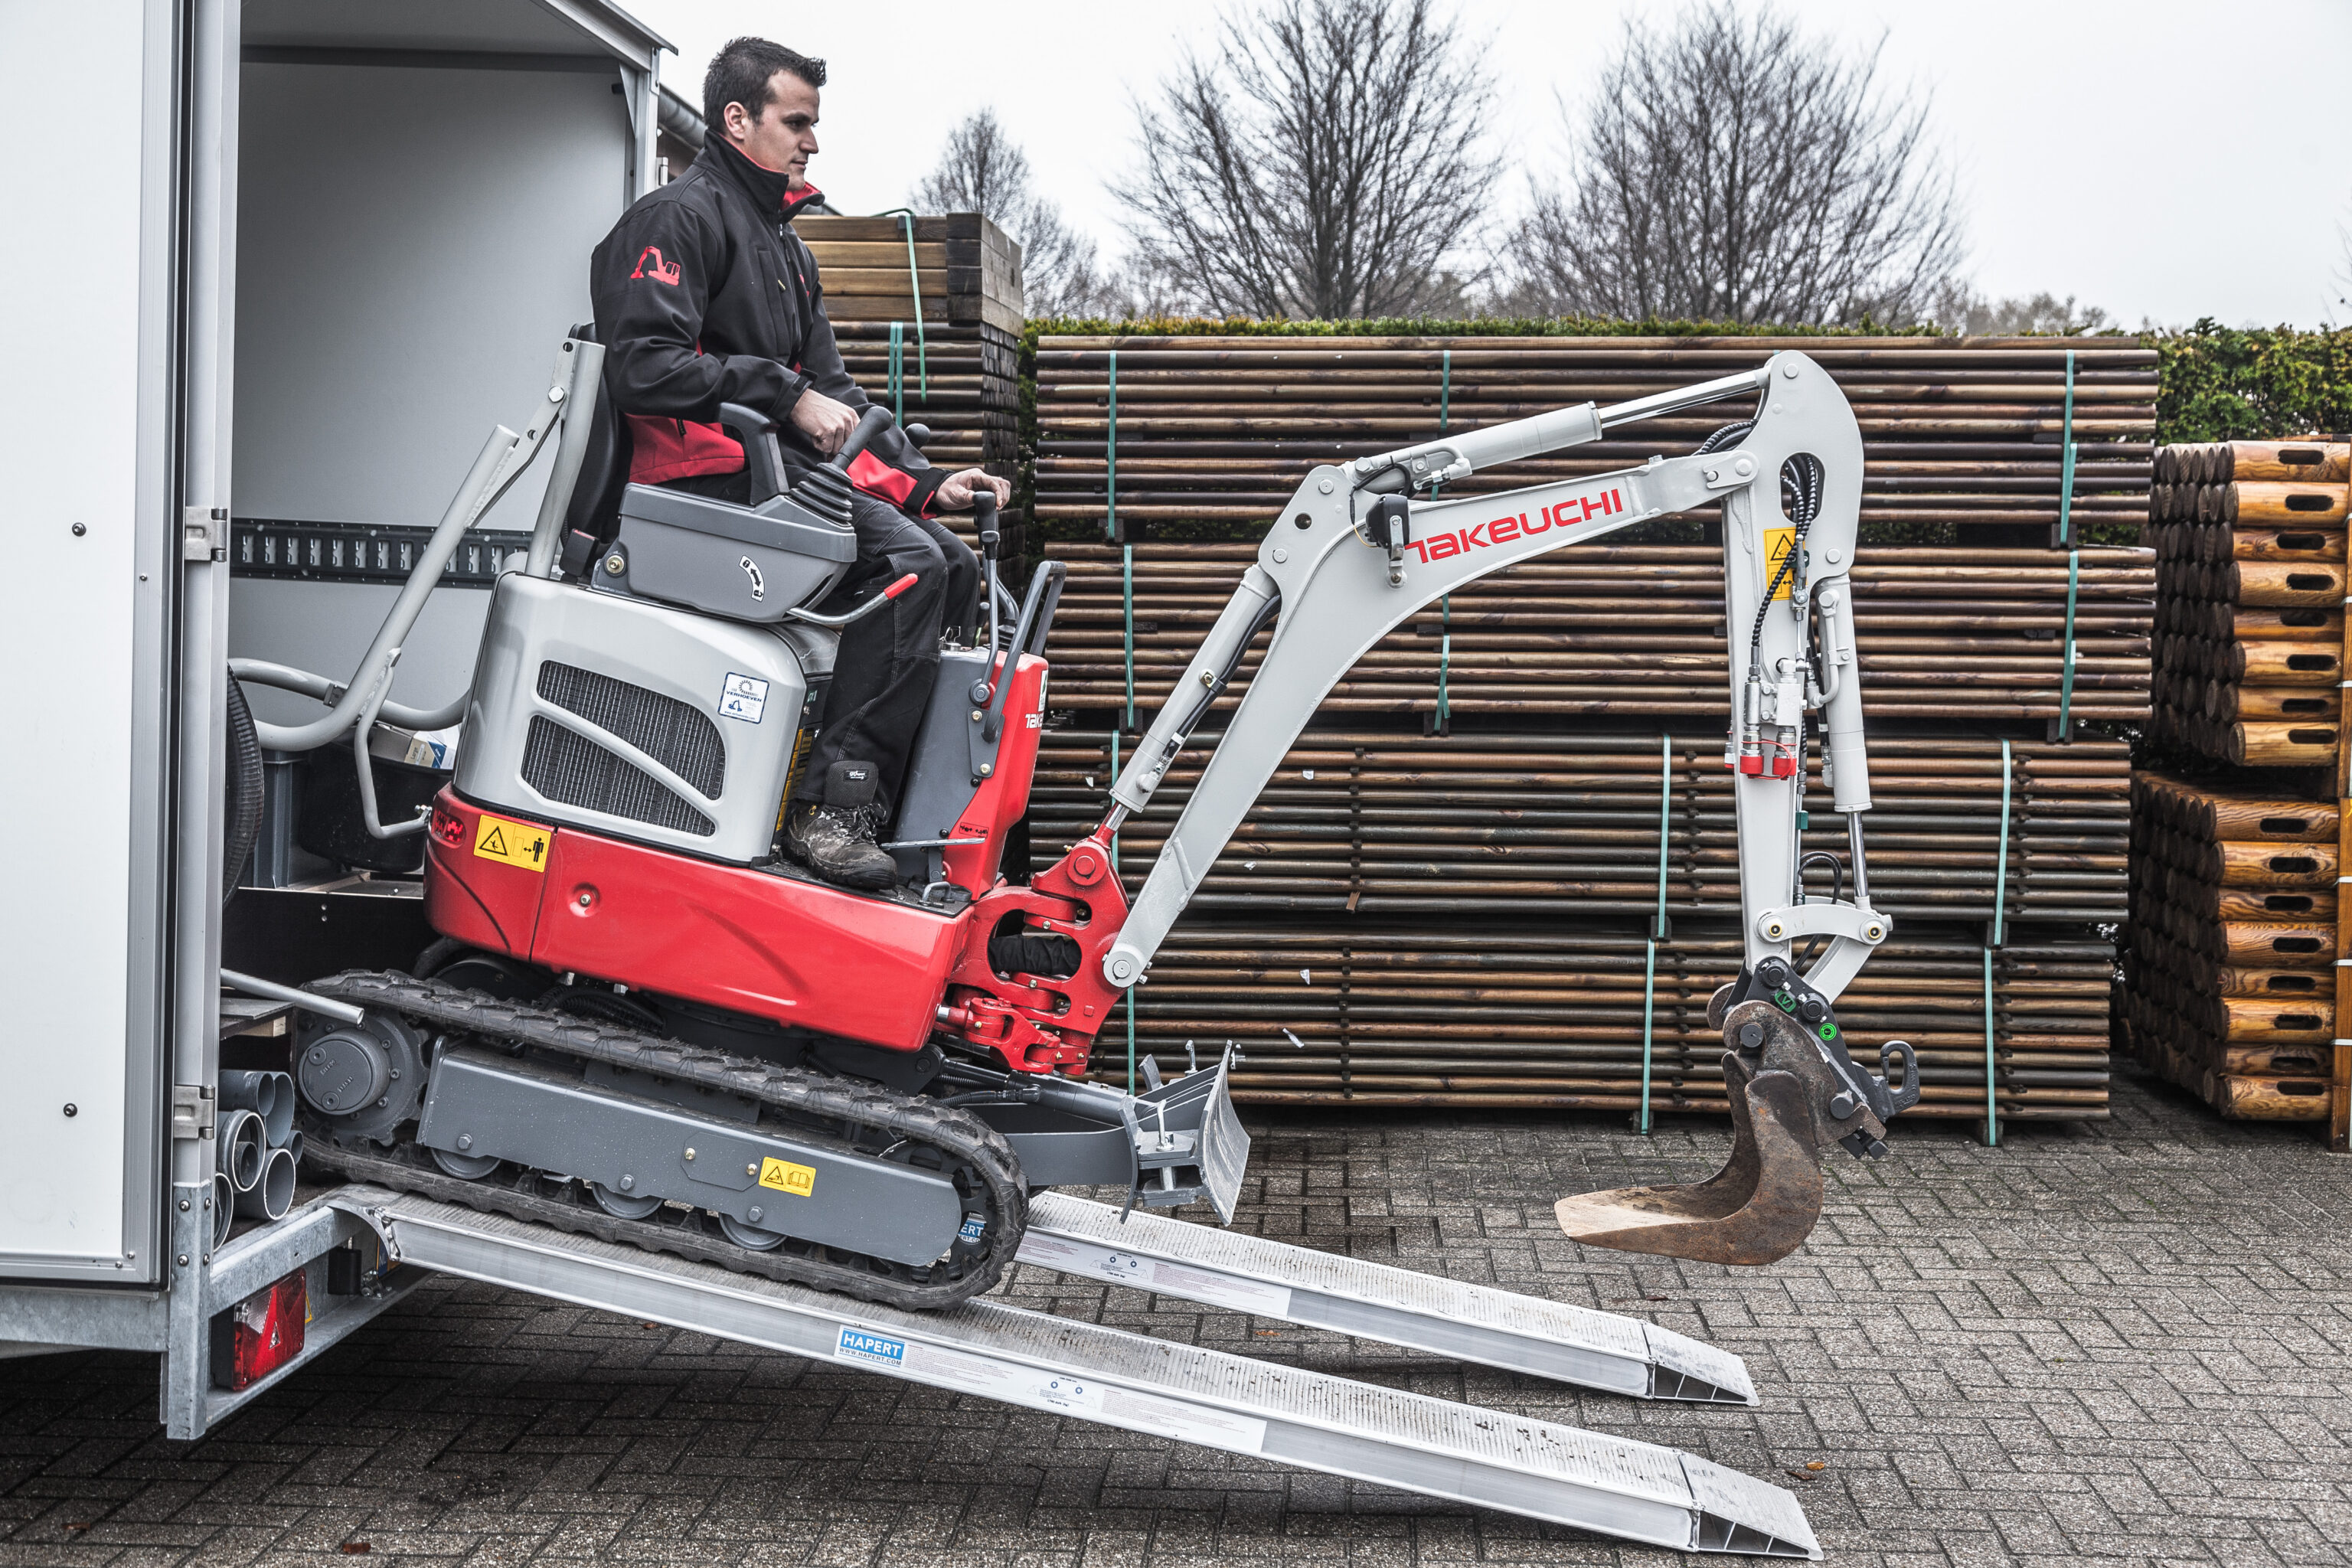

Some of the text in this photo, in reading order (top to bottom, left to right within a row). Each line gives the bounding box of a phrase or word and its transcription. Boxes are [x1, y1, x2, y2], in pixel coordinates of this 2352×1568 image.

[726, 690, 763, 703] VERHOEVEN
[961, 1223, 984, 1237] ERT
[843, 1333, 902, 1357] HAPERT
[839, 1347, 902, 1366] WWW.HAPERT.COM
